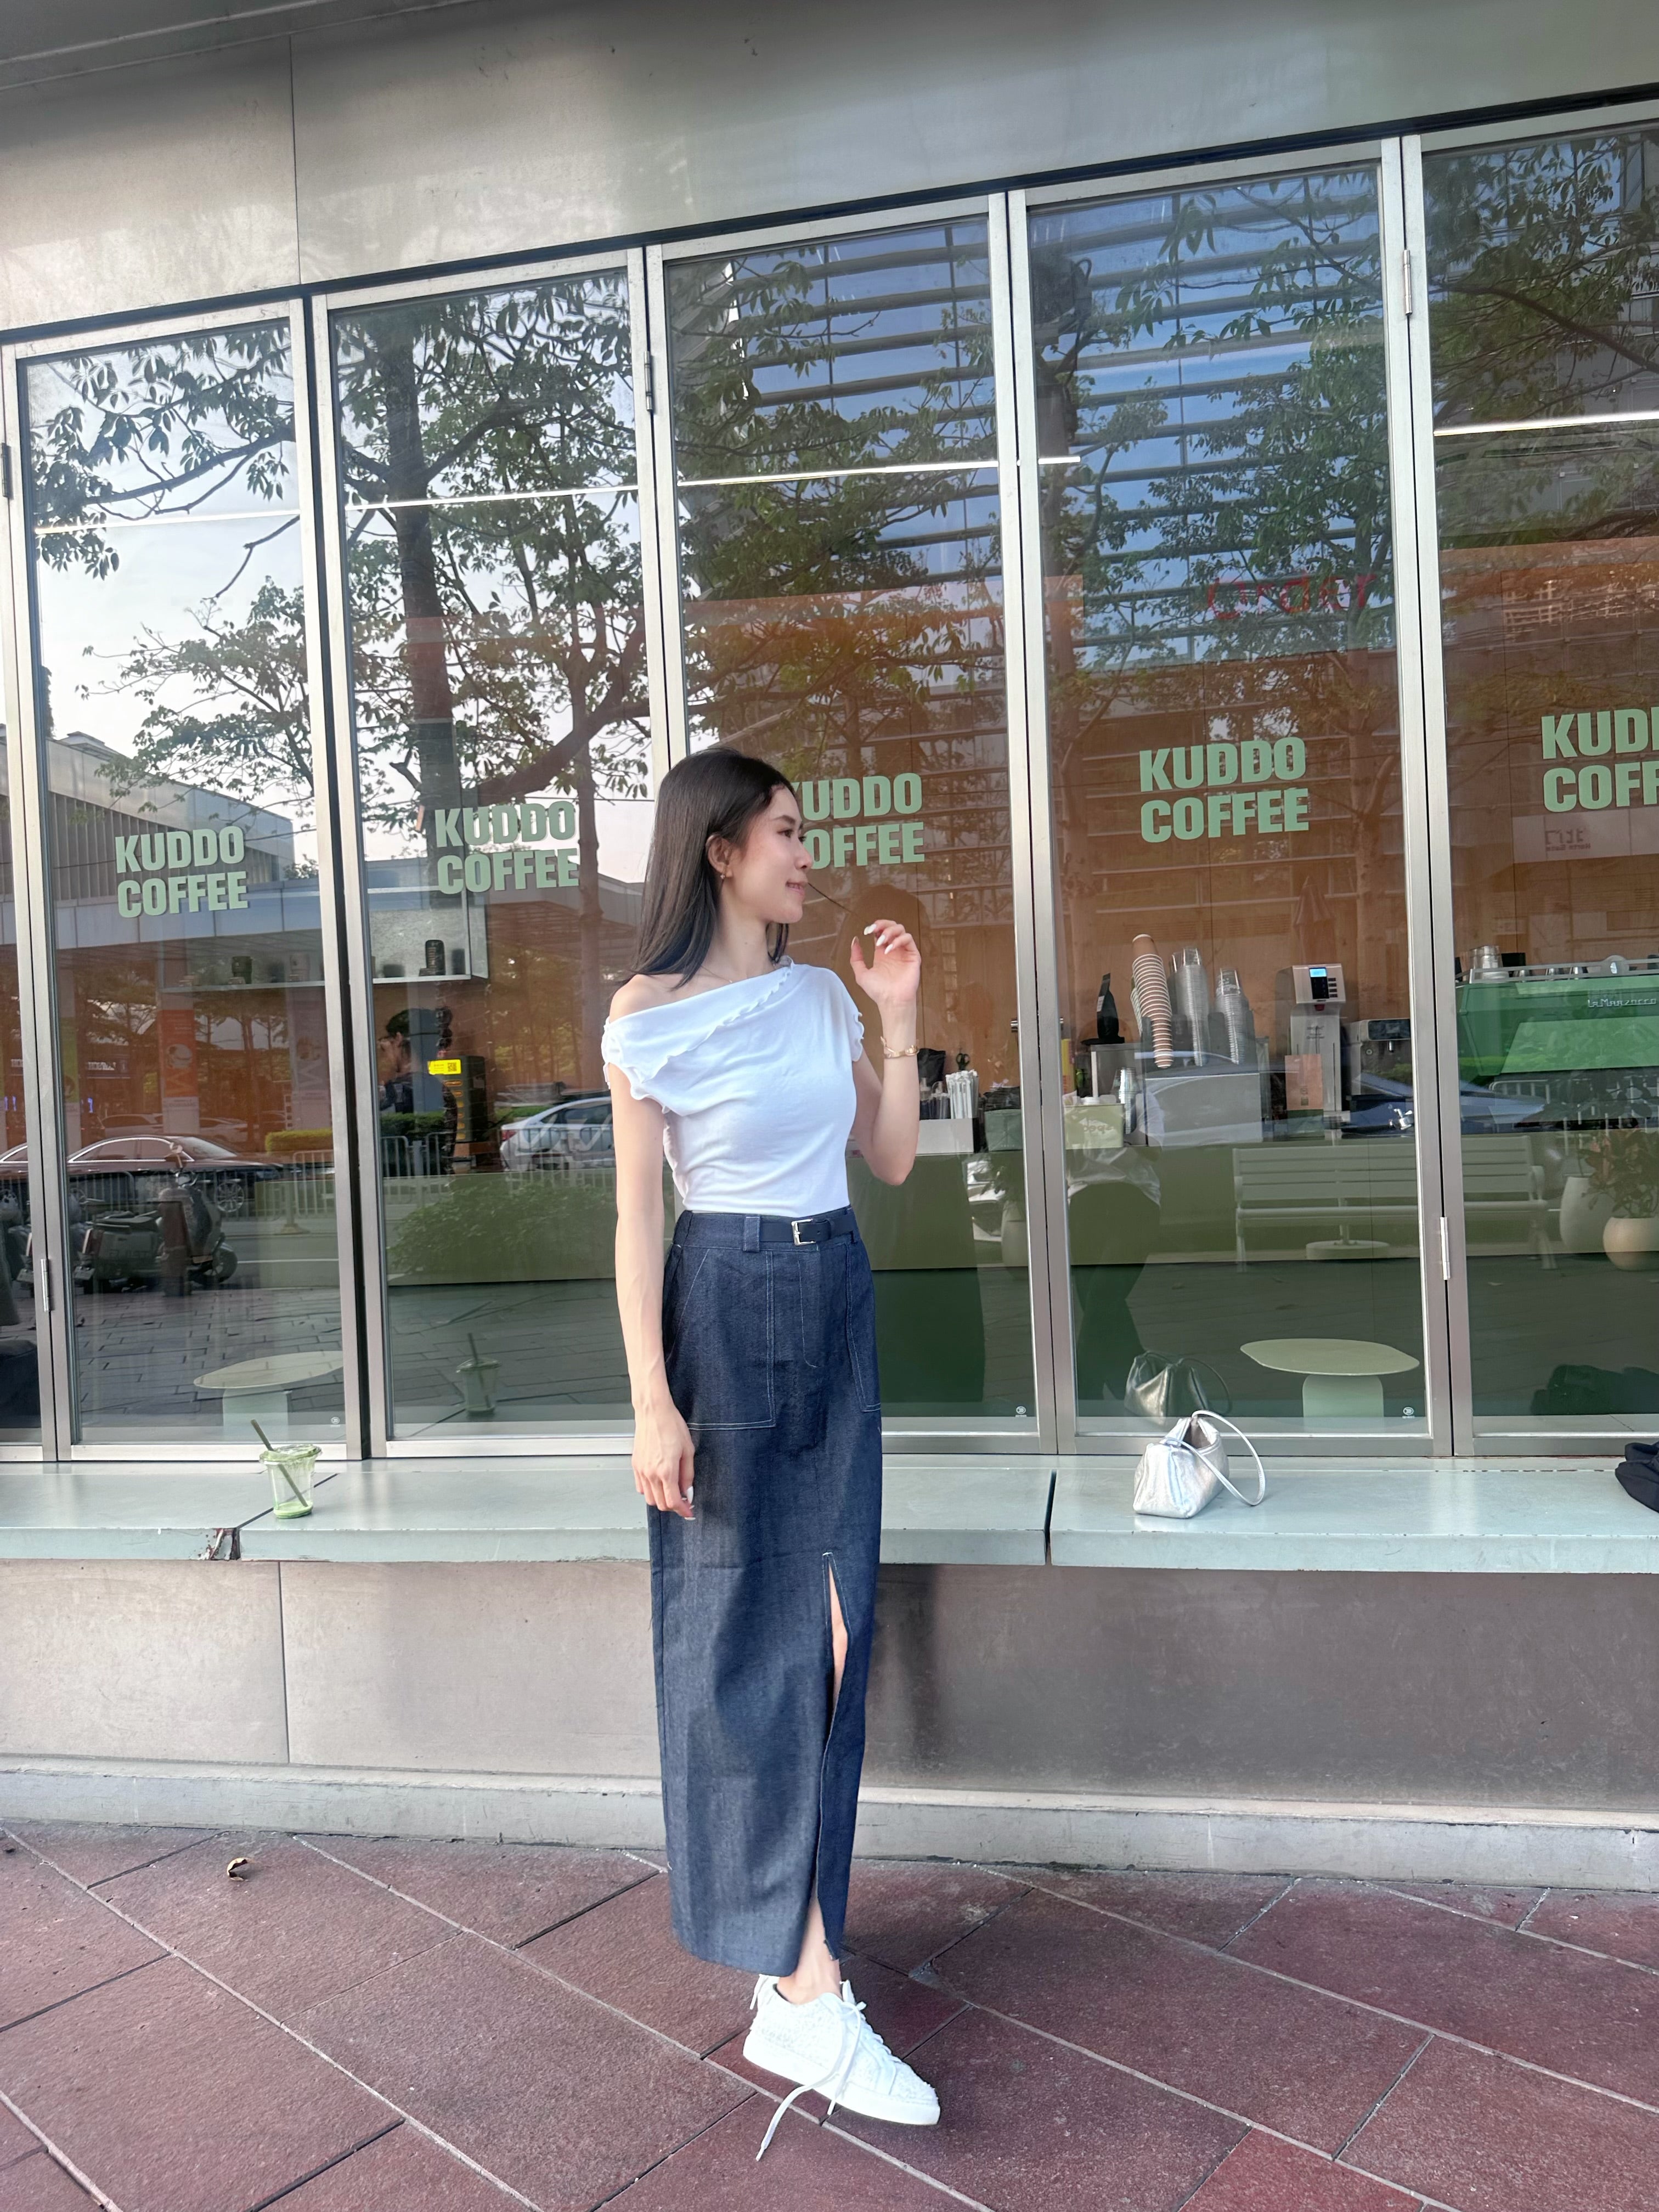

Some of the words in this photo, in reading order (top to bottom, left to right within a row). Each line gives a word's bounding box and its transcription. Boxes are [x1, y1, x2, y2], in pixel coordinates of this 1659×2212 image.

[1541, 706, 1659, 760] KUD
[1139, 737, 1306, 792] KUDDO
[791, 772, 923, 821] UDDO
[1141, 788, 1310, 843] COFFEE
[435, 800, 576, 848] KUDDO
[803, 822, 925, 870] OFFEE
[115, 826, 245, 874] KUDDO
[437, 848, 579, 895] COFFEE
[117, 871, 249, 918] COFFEE
